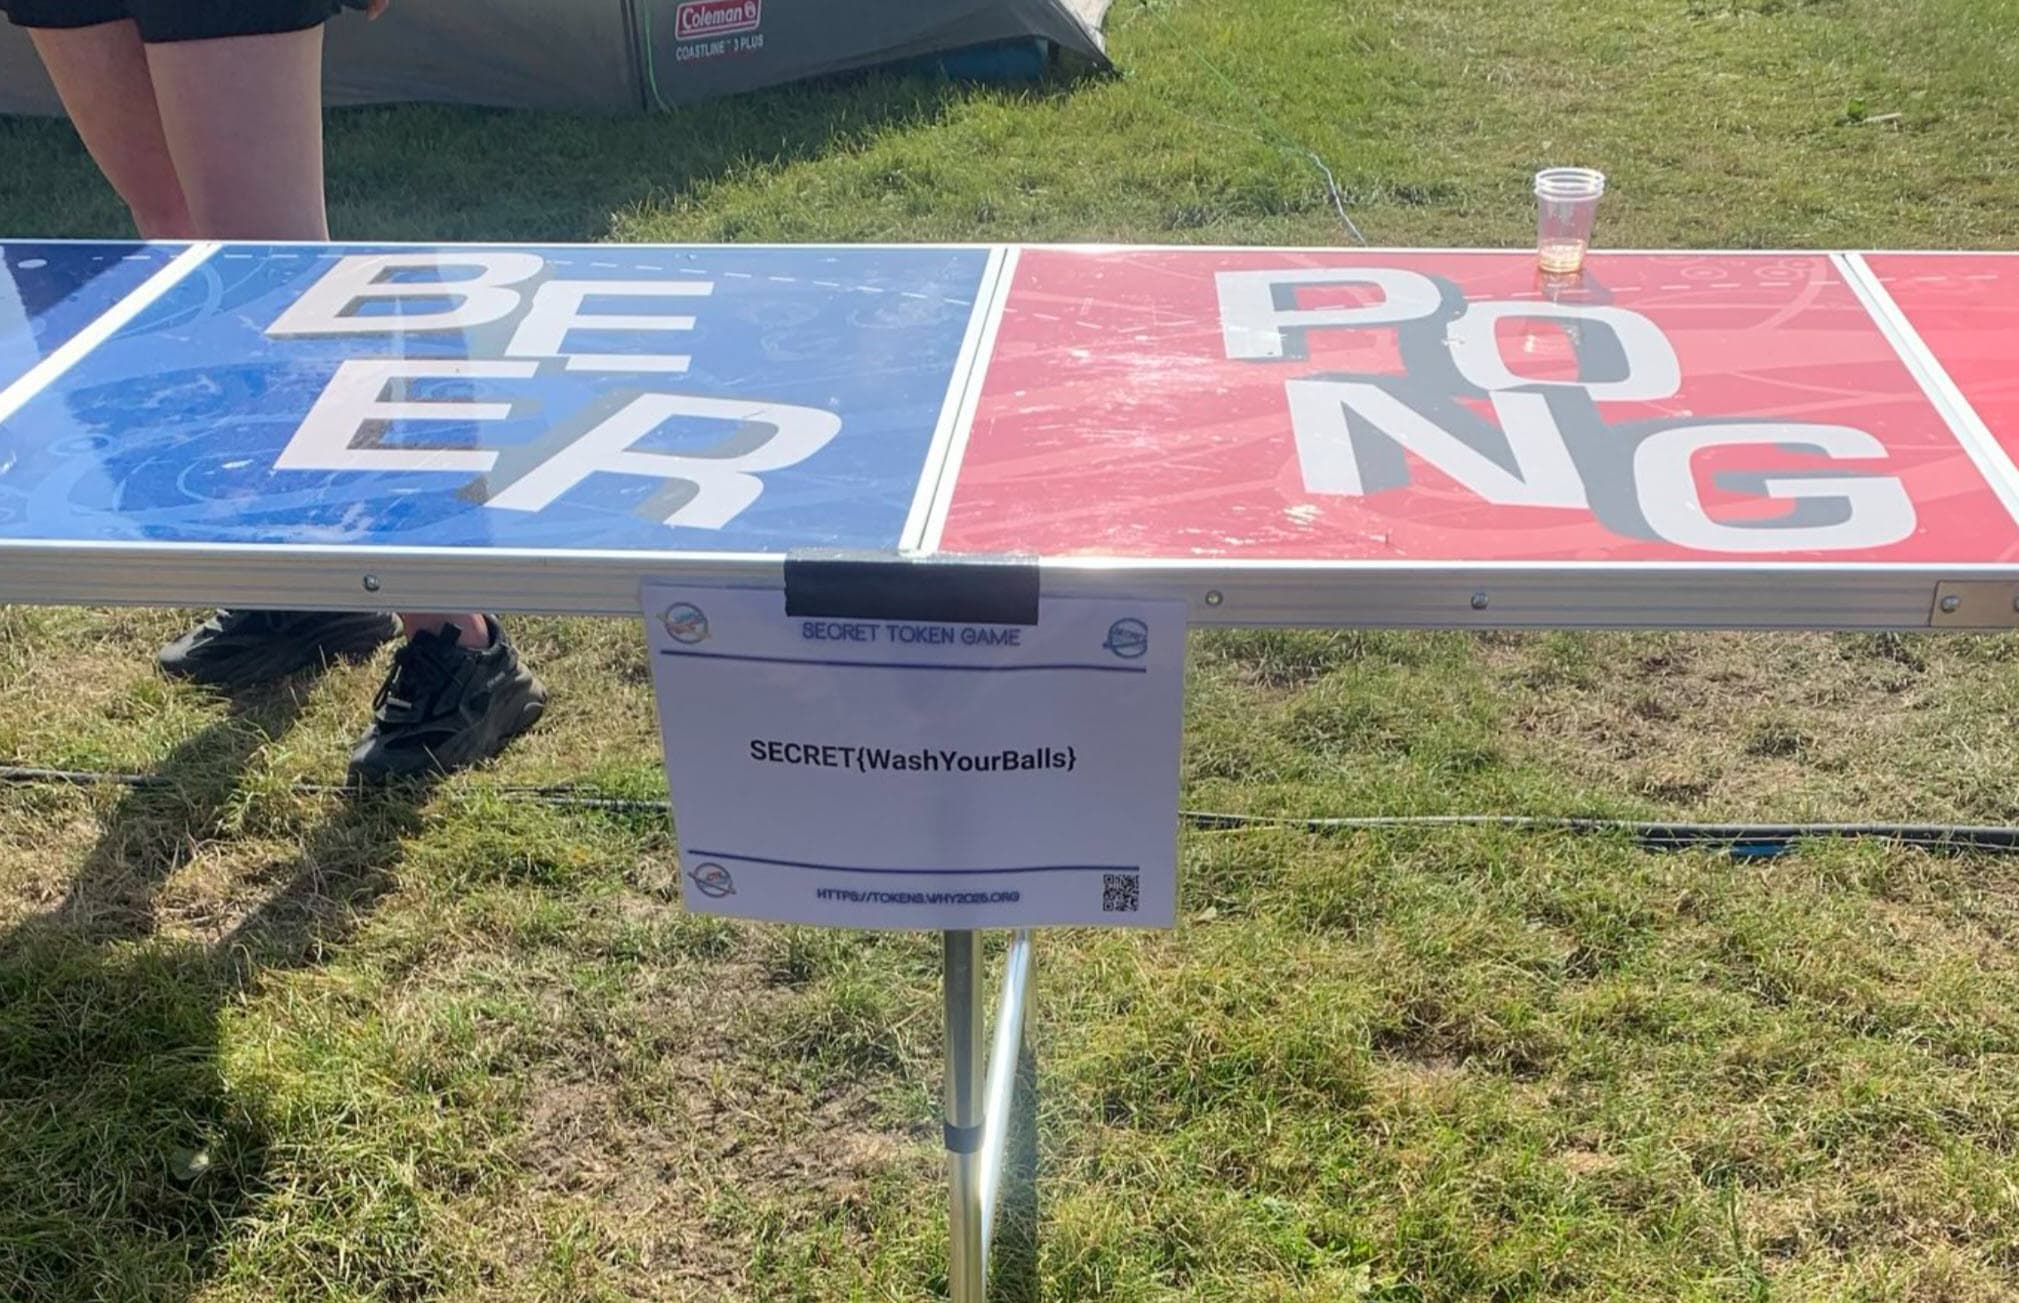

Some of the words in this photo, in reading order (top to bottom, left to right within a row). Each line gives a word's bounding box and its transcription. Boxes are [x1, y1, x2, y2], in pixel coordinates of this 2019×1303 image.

[741, 34, 764, 51] PLUS
[802, 622, 880, 642] SECRET
[887, 624, 954, 644] TOKEN
[960, 627, 1021, 646] GAME
[750, 739, 1077, 773] SECRET{WashYourBalls}
